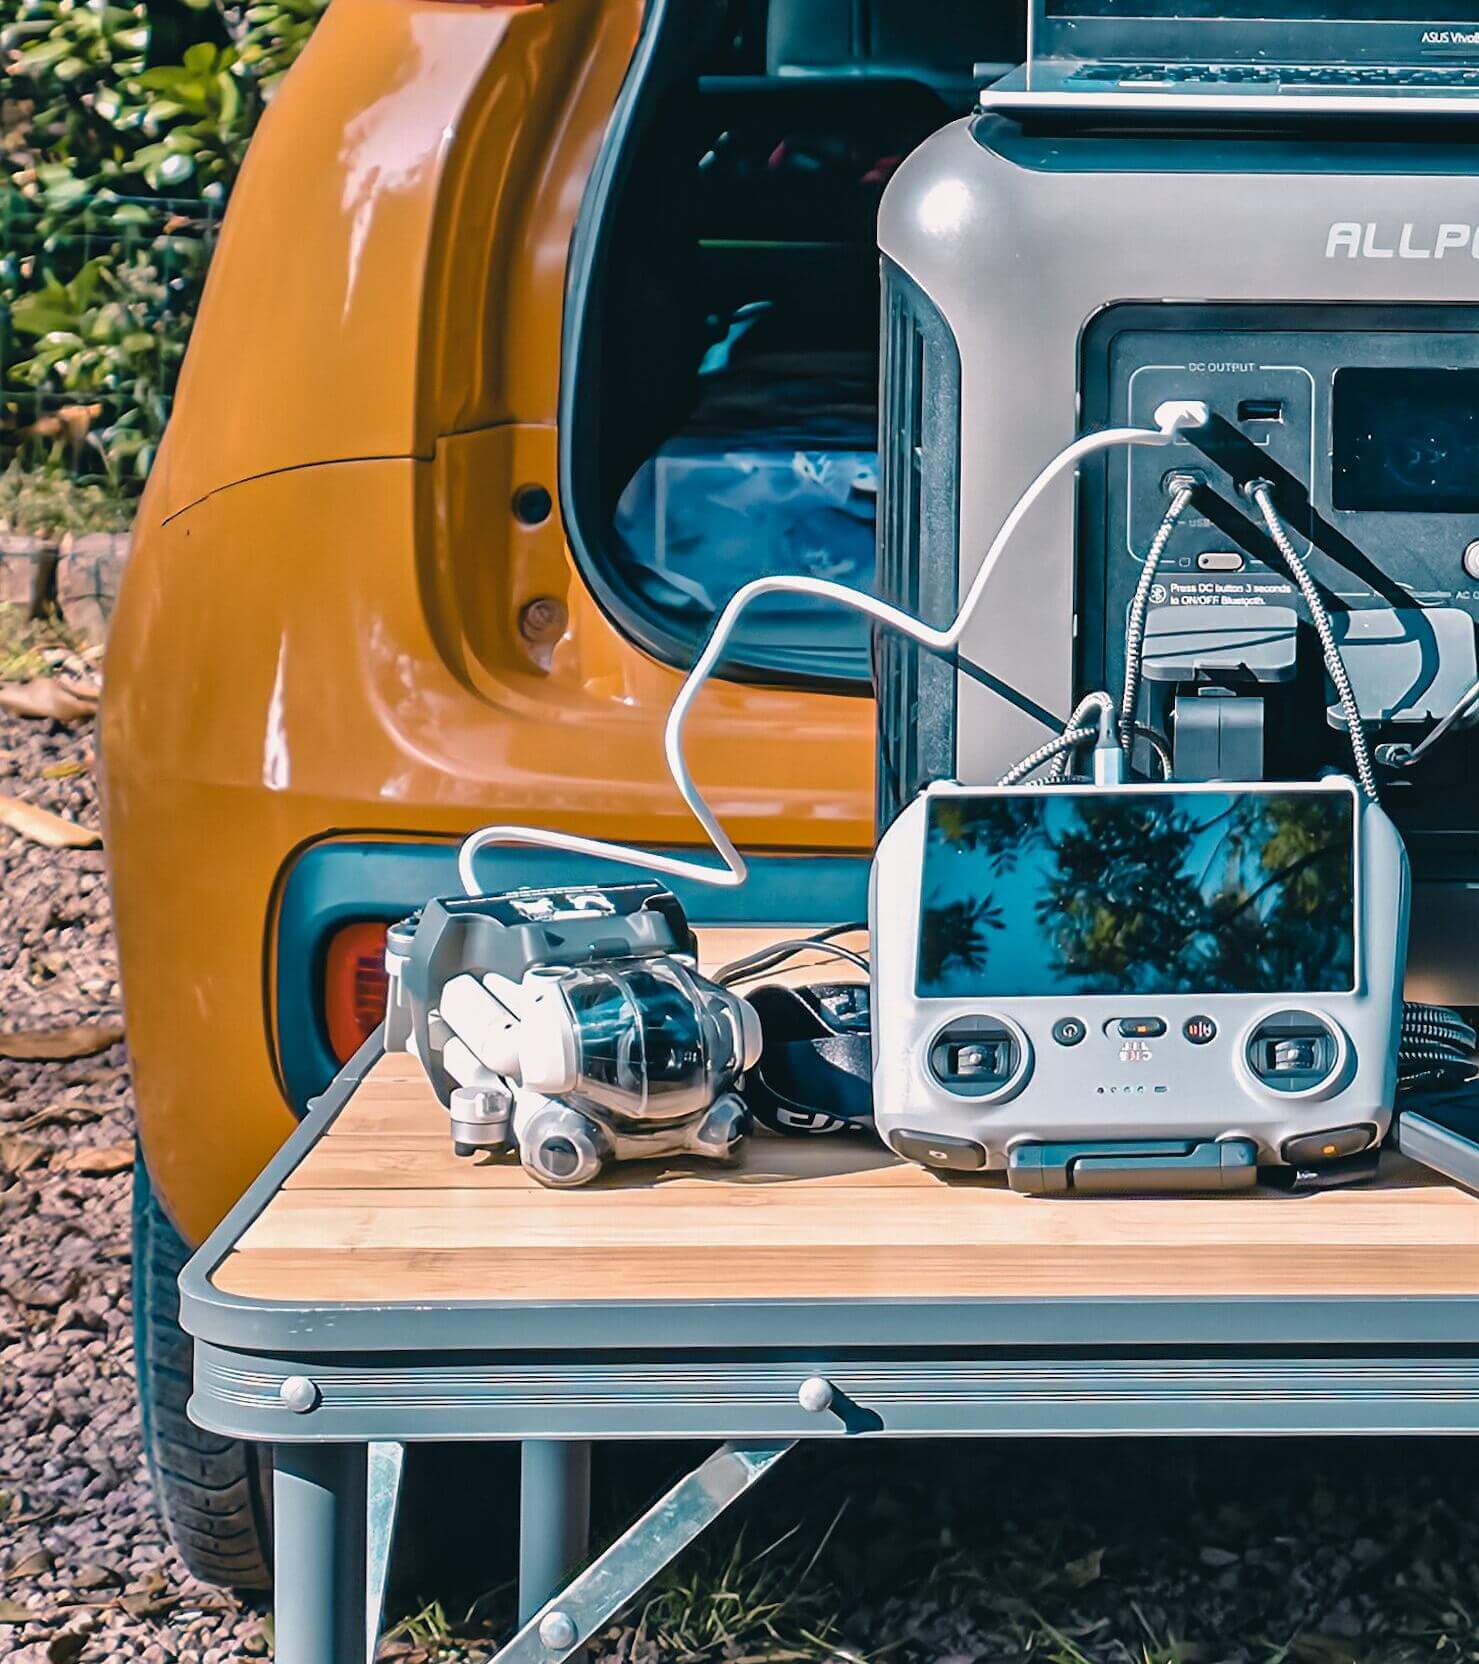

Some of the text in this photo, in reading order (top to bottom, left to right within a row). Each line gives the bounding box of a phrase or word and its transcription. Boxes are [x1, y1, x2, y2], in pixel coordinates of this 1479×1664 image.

[1421, 31, 1449, 43] ASUS
[1188, 362, 1255, 372] DC OUTPUT
[1170, 583, 1292, 593] Press DC button 3 seconds
[1170, 595, 1180, 605] to
[1181, 595, 1220, 605] ON/OFF
[1455, 591, 1470, 600] AC
